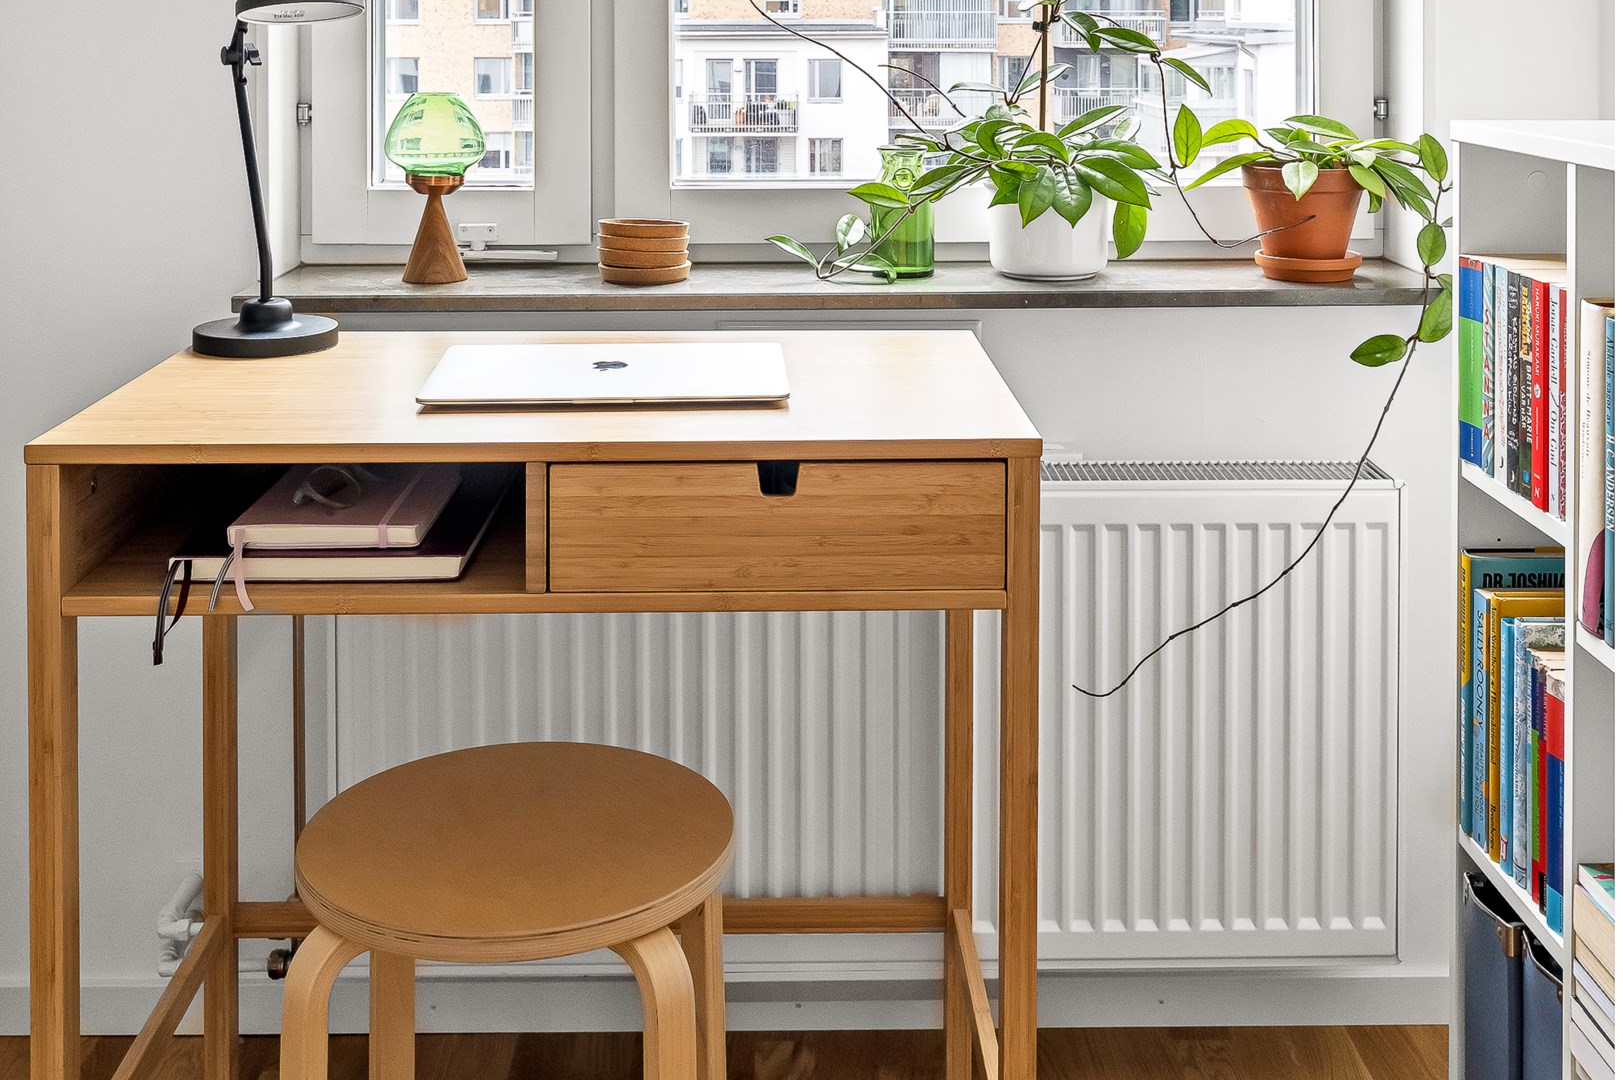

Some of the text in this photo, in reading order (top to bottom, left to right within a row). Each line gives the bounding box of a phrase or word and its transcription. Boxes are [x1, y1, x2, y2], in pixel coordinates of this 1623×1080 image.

[1483, 308, 1491, 440] STANNA
[1550, 297, 1558, 467] Jonas Gardell Om Gud
[1605, 382, 1613, 411] sagor
[1606, 414, 1612, 427] av
[1606, 462, 1615, 533] ANDERSEN
[1483, 573, 1504, 589] DR
[1501, 663, 1506, 677] TO
